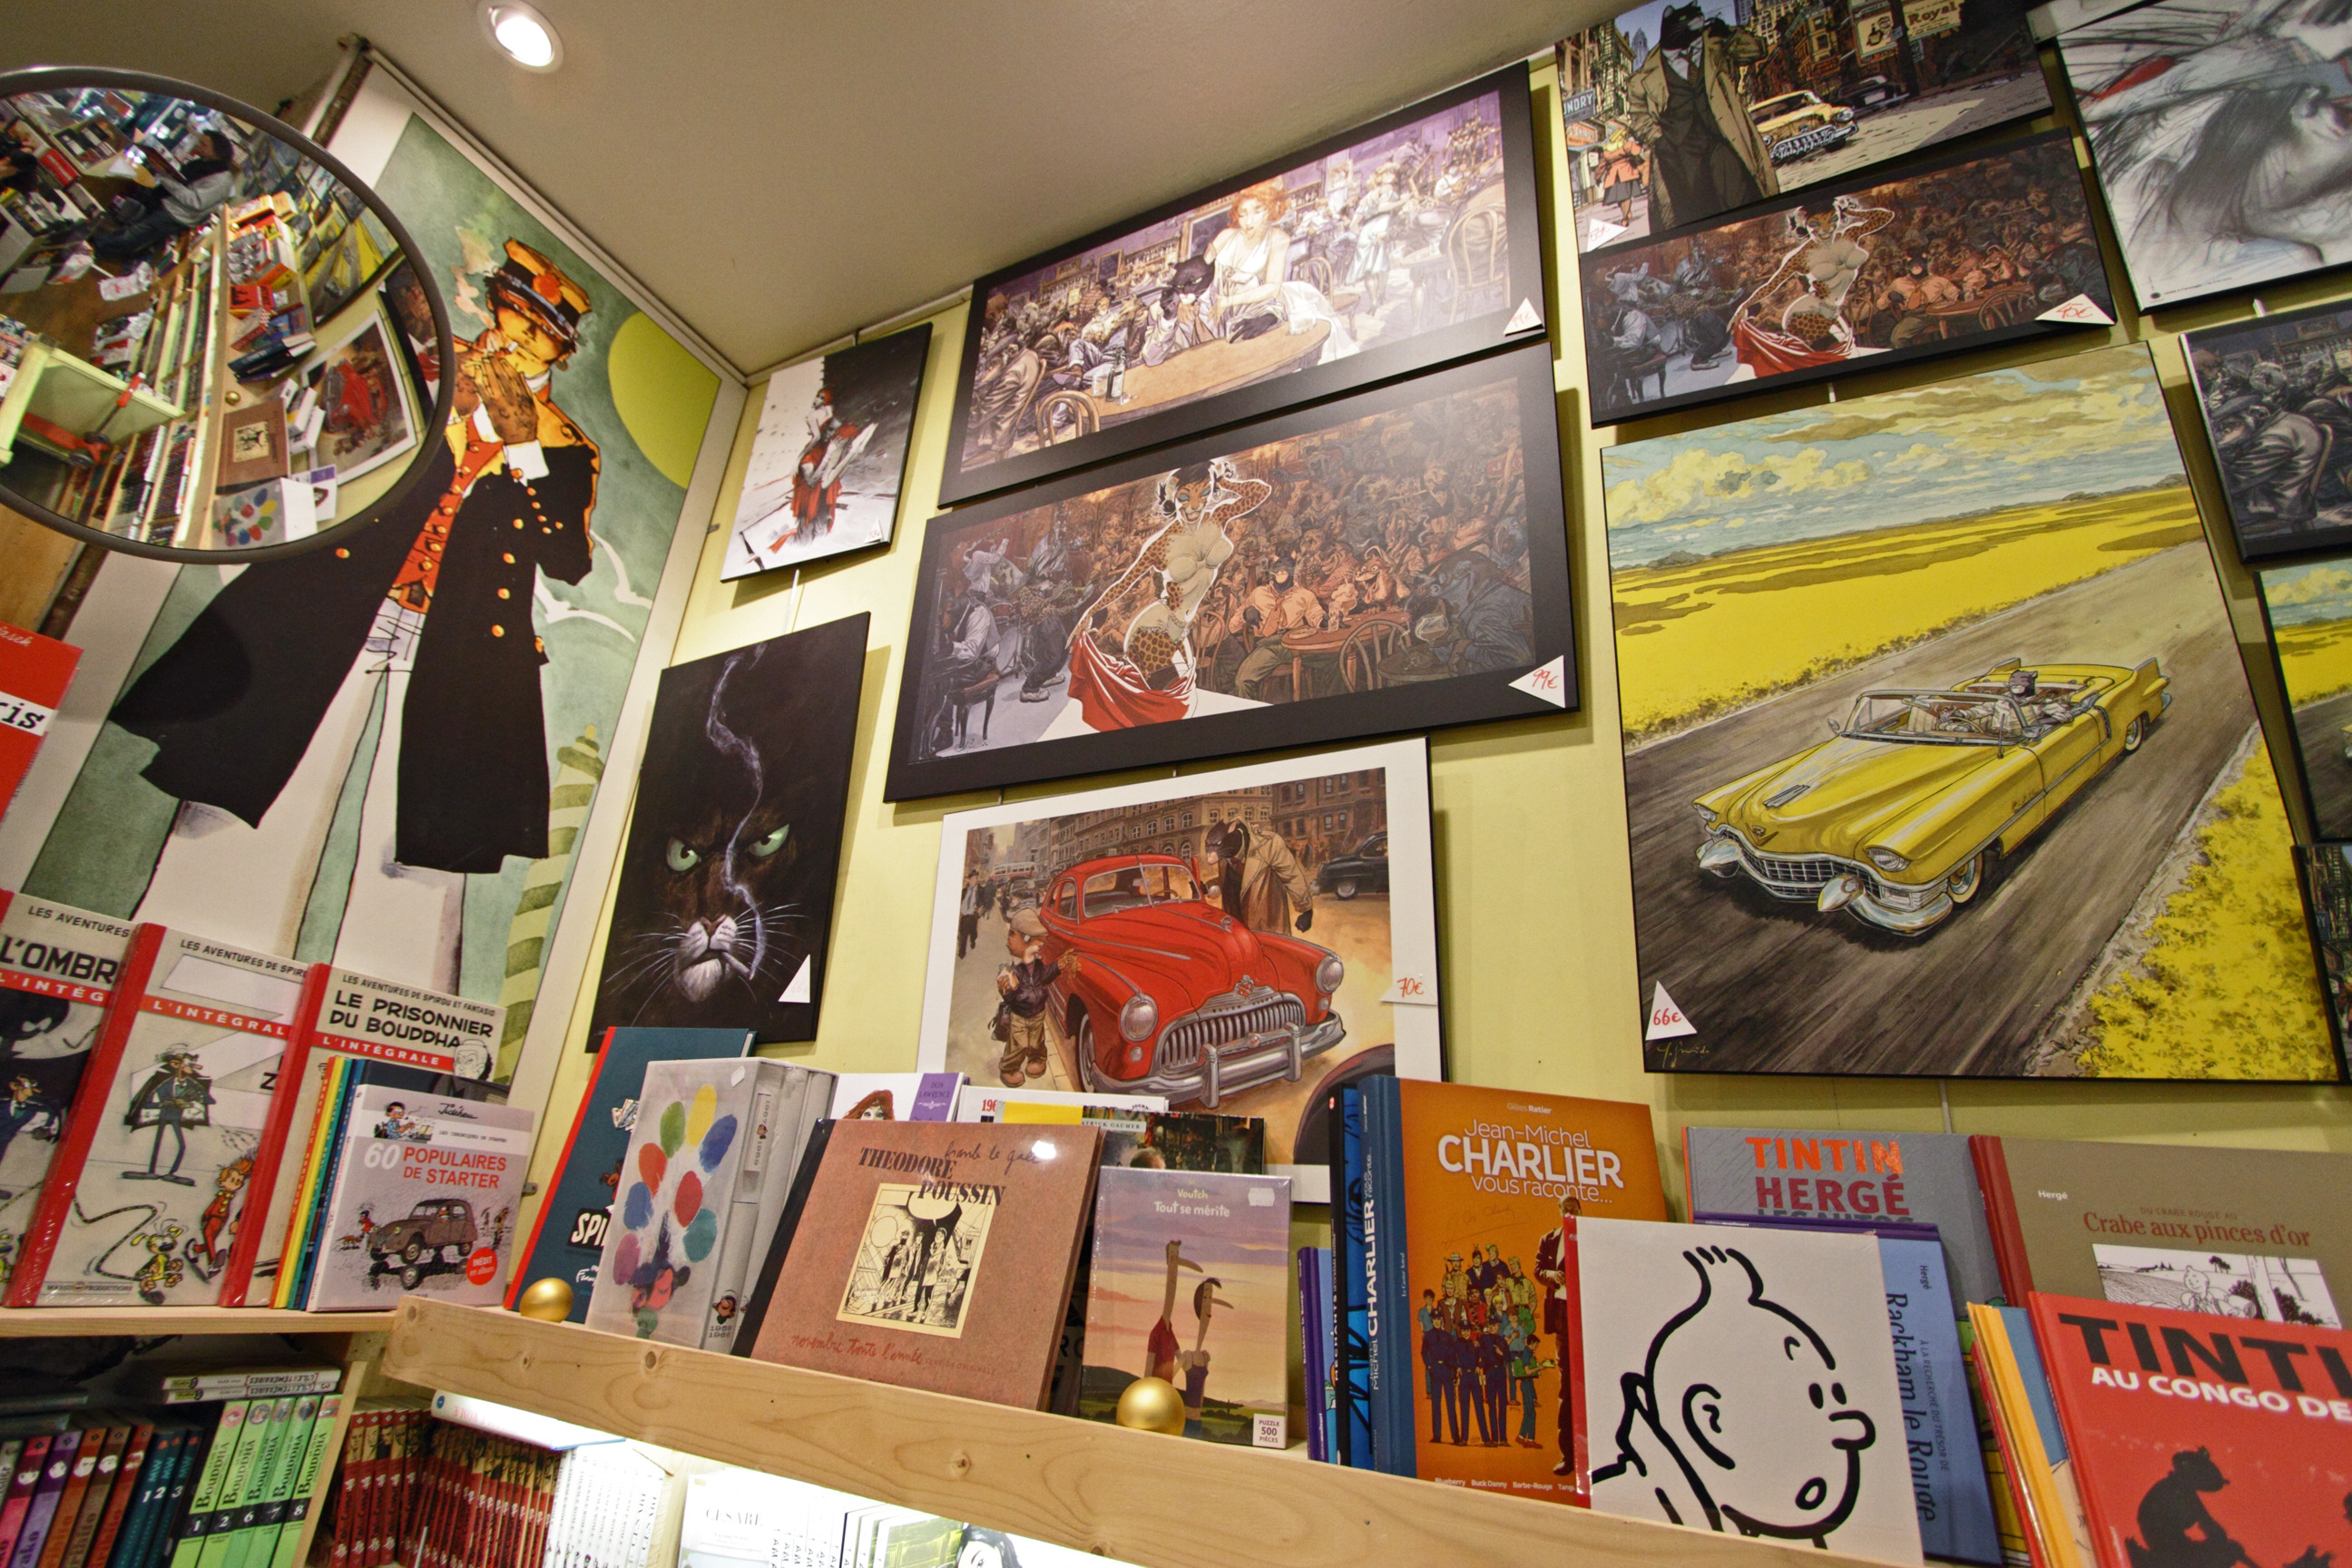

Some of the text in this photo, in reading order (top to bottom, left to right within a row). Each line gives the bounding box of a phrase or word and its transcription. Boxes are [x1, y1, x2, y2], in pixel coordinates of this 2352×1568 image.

[2056, 303, 2093, 318] 45€
[1533, 670, 1557, 690] 99€
[28, 906, 131, 938] LES AVENTURES
[0, 936, 118, 984] L'OMBR
[180, 939, 201, 951] LES
[202, 946, 264, 968] AVENTURES
[266, 961, 279, 971] DE
[0, 973, 104, 1003] L'INTÉG
[343, 975, 496, 1017] LES AVENTURES DE SPIROU ET FANTASIO
[1396, 977, 1424, 998] 70€
[152, 1001, 286, 1035] L'INTÉGRAL
[335, 990, 494, 1037] LE PRISONNIER
[1653, 1009, 1682, 1025] 66€
[328, 1010, 461, 1048] DU BOUDDHA
[323, 1035, 439, 1065] L'INTÉGRALE
[919, 1091, 950, 1099] LAWRENCE
[982, 1099, 996, 1112] 196
[1528, 1104, 1552, 1115] Ratier
[1110, 1122, 1142, 1130] GAUMER
[1465, 1119, 1592, 1149] Jean-Michel
[364, 1142, 506, 1171] 60 POPULAIRES
[858, 1147, 956, 1180] THEODORE
[1437, 1134, 1624, 1189] CHARLIER
[1745, 1137, 1904, 1174] TINTIN
[403, 1166, 499, 1190] DE STARTER
[1471, 1175, 1520, 1195] vous
[917, 1180, 1006, 1206] POUSSIN
[1177, 1188, 1208, 1200] Voutch
[1755, 1173, 1910, 1216] HERGÉ
[2038, 1190, 2069, 1201] Hergé
[1154, 1200, 1230, 1218] Tout se mérite
[570, 1212, 608, 1248] SPI
[2083, 1211, 2311, 1248] Crabe aux pinces d'or
[1364, 1199, 1378, 1336] CHARLIER
[1919, 1265, 1931, 1289] Hergé
[791, 1332, 844, 1353] novembre
[2058, 1313, 2352, 1399] TINTI
[2092, 1367, 2140, 1391] AU
[2149, 1375, 2290, 1414] CONGO
[1886, 1292, 1936, 1523] Rackham le Rouge
[1921, 1357, 1936, 1406] RECHERCHE
[1934, 1419, 1946, 1455] TRÉSOR
[1261, 1426, 1278, 1436] 500
[142, 1490, 152, 1503] 1
[153, 1486, 167, 1499] 2
[172, 1485, 182, 1498] 3
[1470, 1479, 1487, 1487] Buck
[1487, 1480, 1507, 1489] Danny
[1513, 1481, 1553, 1491] Barbe-Rouge
[1557, 1483, 1575, 1493] Tang
[219, 1516, 230, 1528] 2
[243, 1510, 254, 1523] 6
[267, 1505, 282, 1519] 7
[293, 1504, 304, 1516] 8
[192, 1520, 201, 1532] 1
